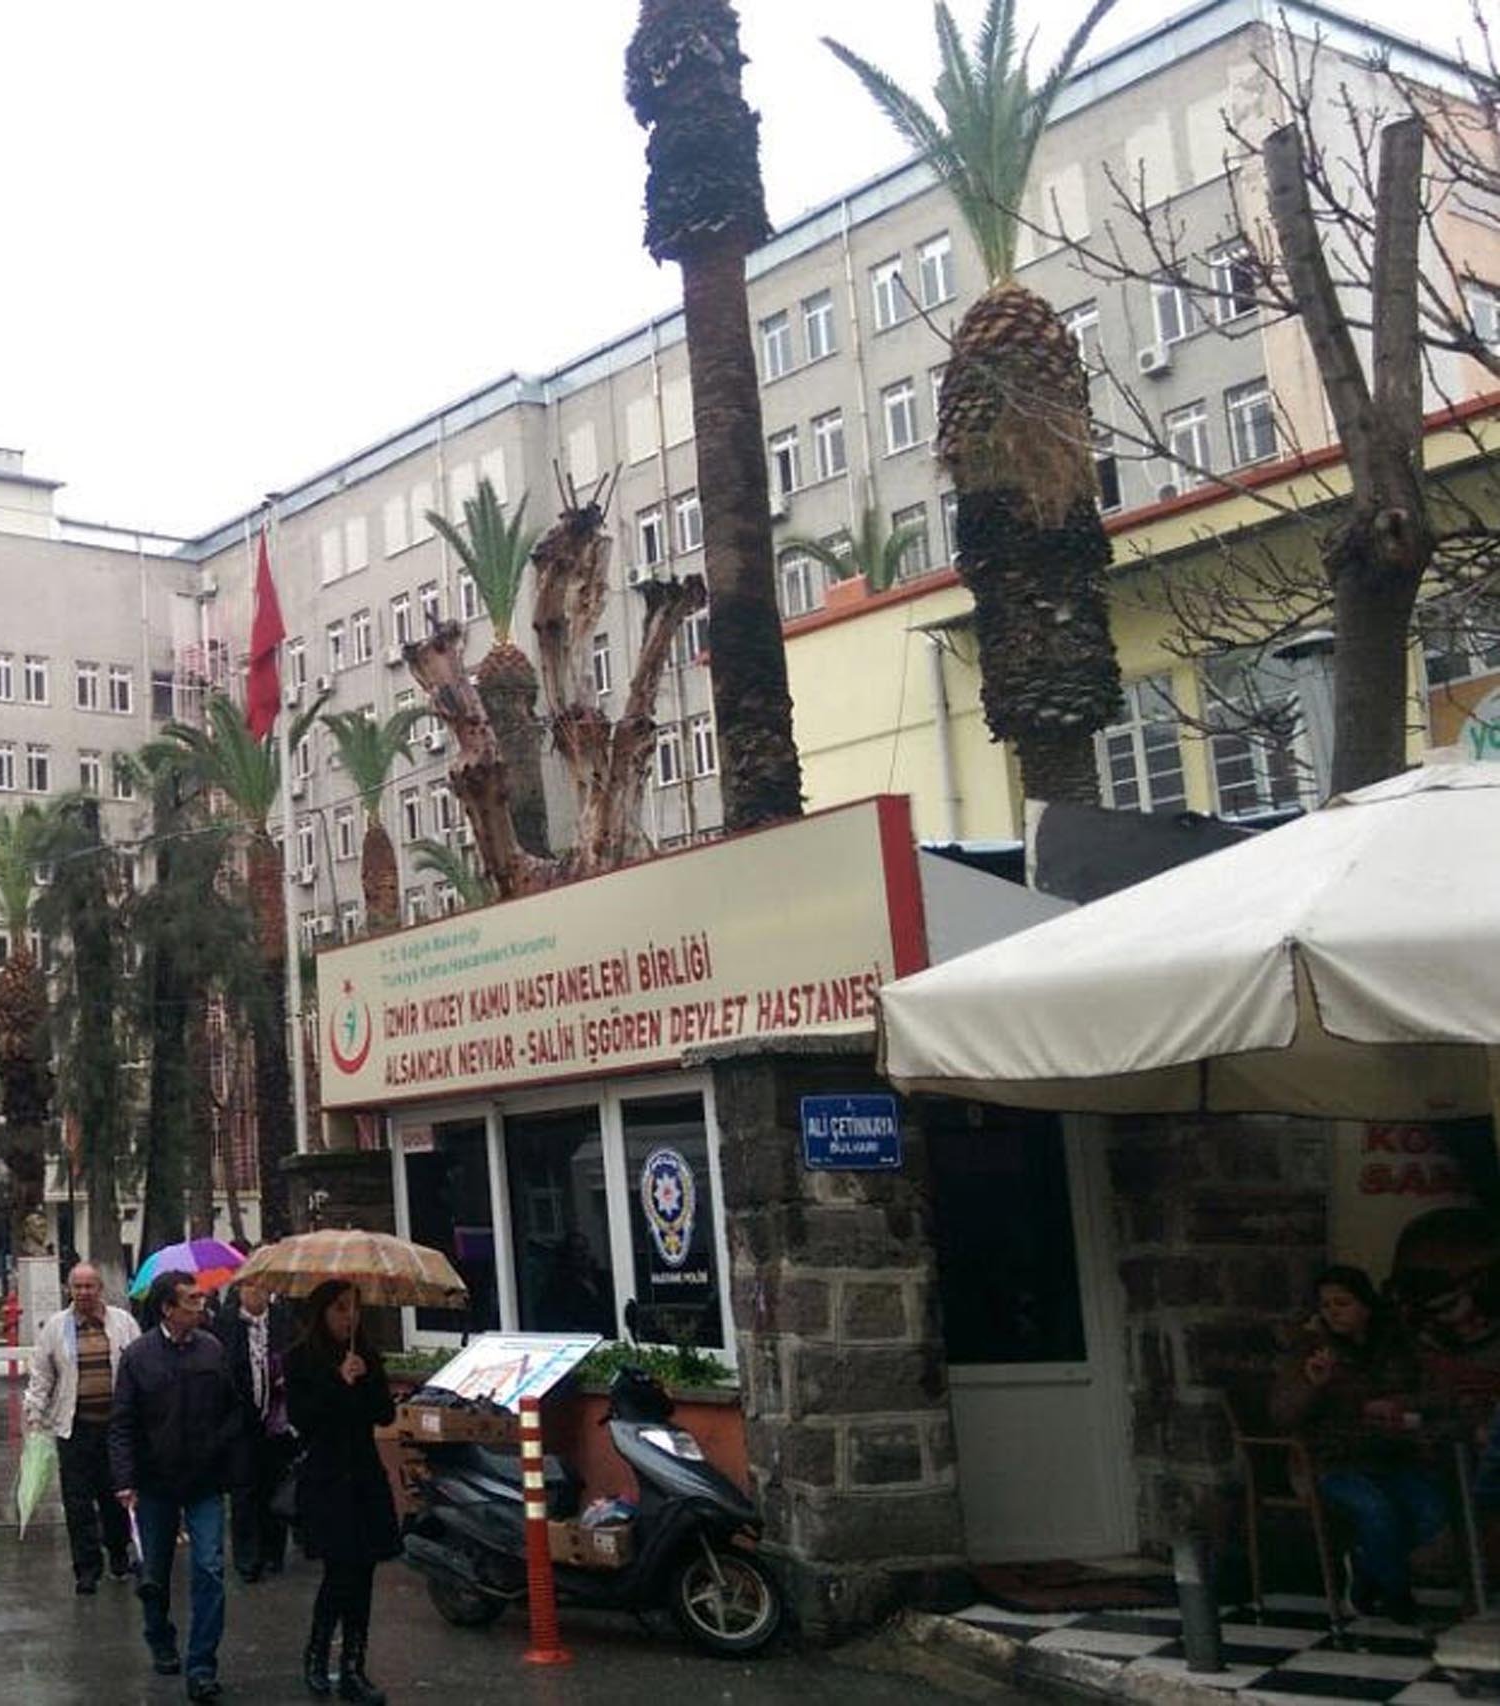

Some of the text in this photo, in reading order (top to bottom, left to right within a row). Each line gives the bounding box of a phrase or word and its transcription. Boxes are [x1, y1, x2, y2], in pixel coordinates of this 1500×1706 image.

[383, 930, 713, 1040] İZMİR KUZEY KAMU HASTANELERİ BİRLİĞİ
[385, 1043, 454, 1087] ALSANCAK
[458, 1034, 515, 1076] NEVVAR
[579, 1006, 662, 1064] İŞGÖREN
[668, 993, 748, 1046] DEVLET
